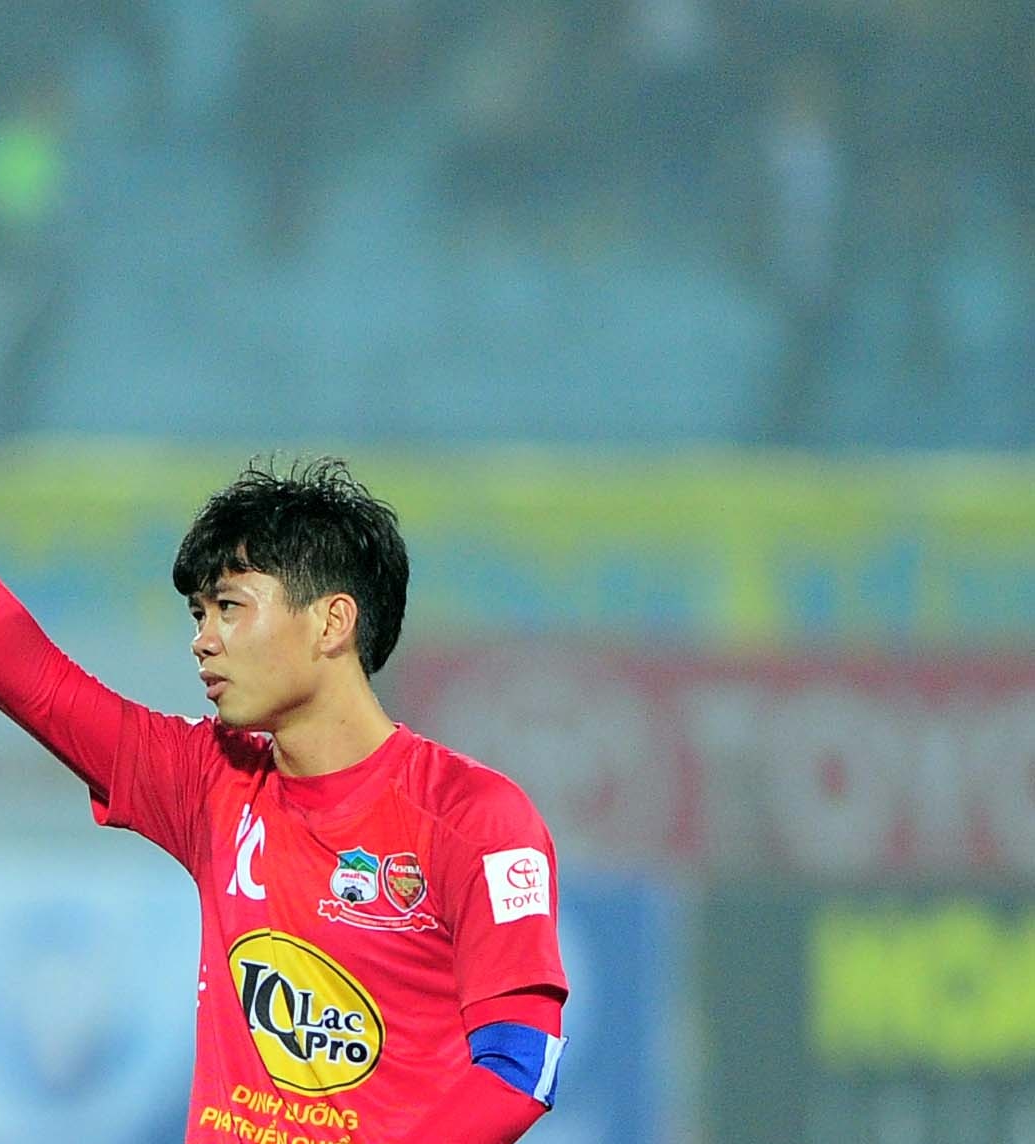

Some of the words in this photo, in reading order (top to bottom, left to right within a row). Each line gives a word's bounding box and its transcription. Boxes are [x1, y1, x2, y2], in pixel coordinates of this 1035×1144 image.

[240, 961, 308, 1060] IQ
[296, 992, 363, 1033] Lac
[305, 1031, 368, 1063] Pro
[231, 1084, 283, 1116] DINH
